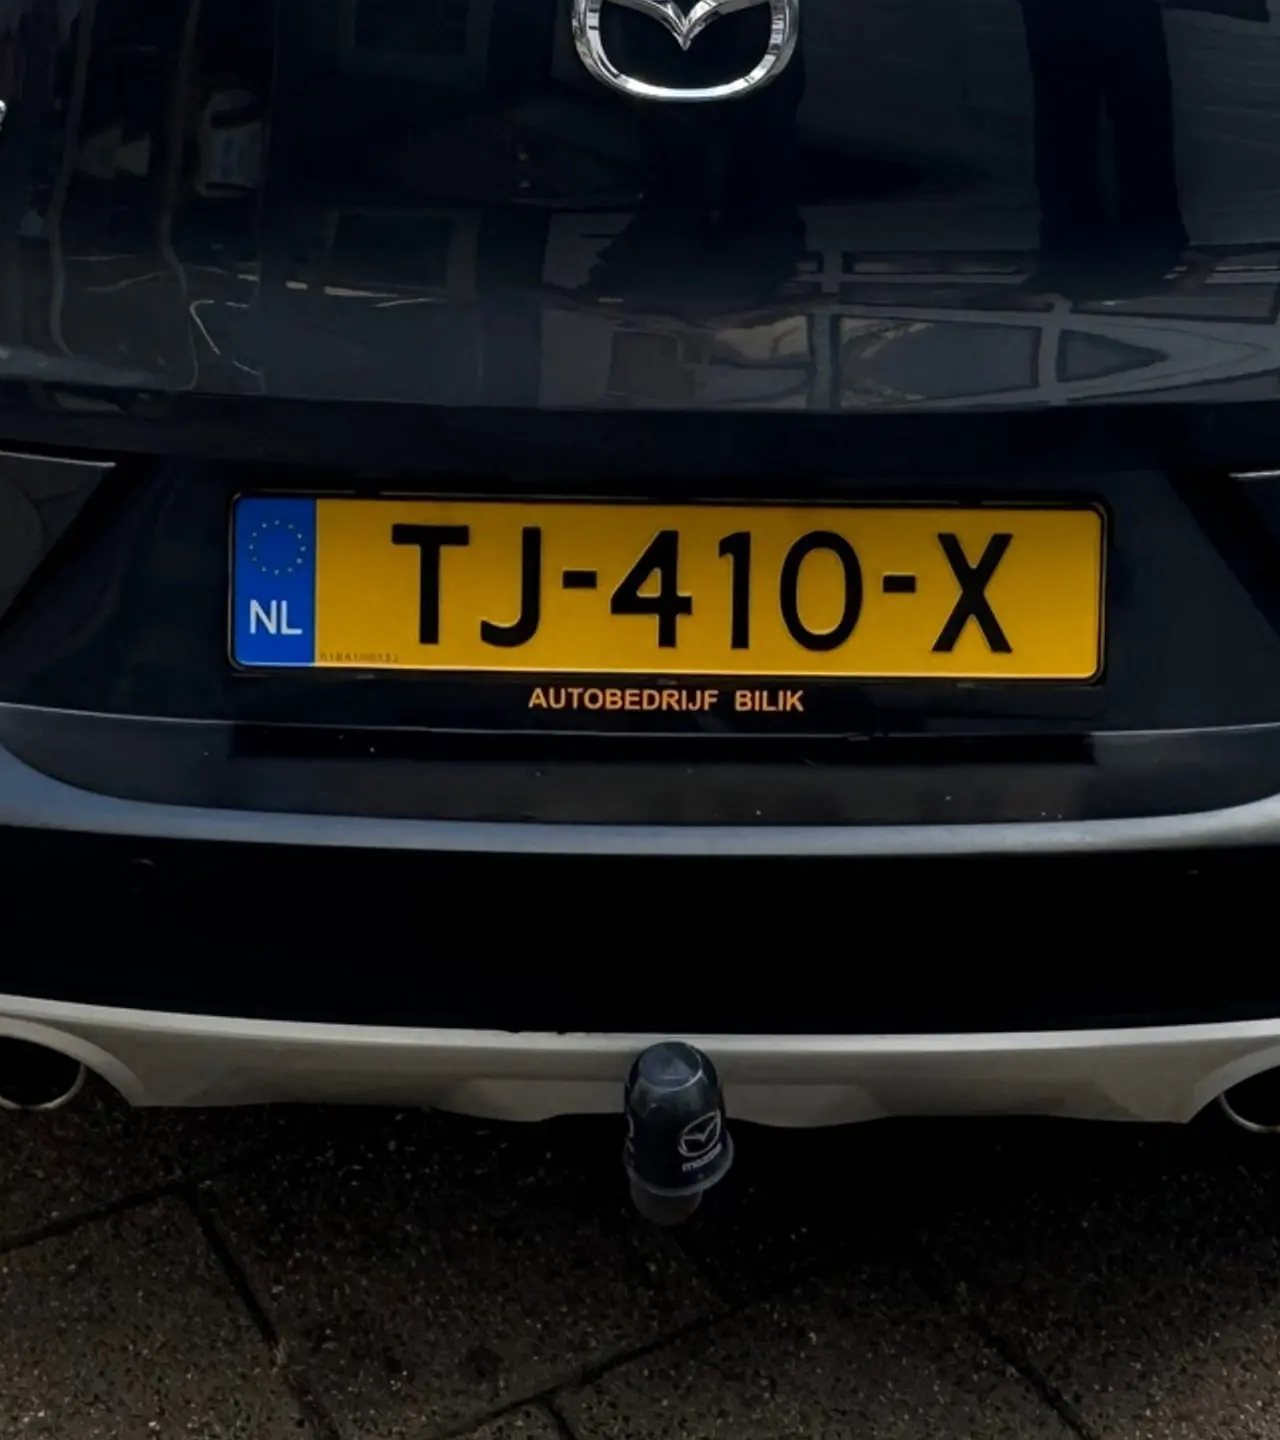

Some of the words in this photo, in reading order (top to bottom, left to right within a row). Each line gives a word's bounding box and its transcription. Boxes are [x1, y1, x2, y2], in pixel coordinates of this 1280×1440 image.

[390, 522, 1015, 654] TJ-410-X
[249, 599, 304, 636] NL
[527, 686, 720, 711] AUTOBEDRIJF
[734, 689, 805, 712] BILIK
